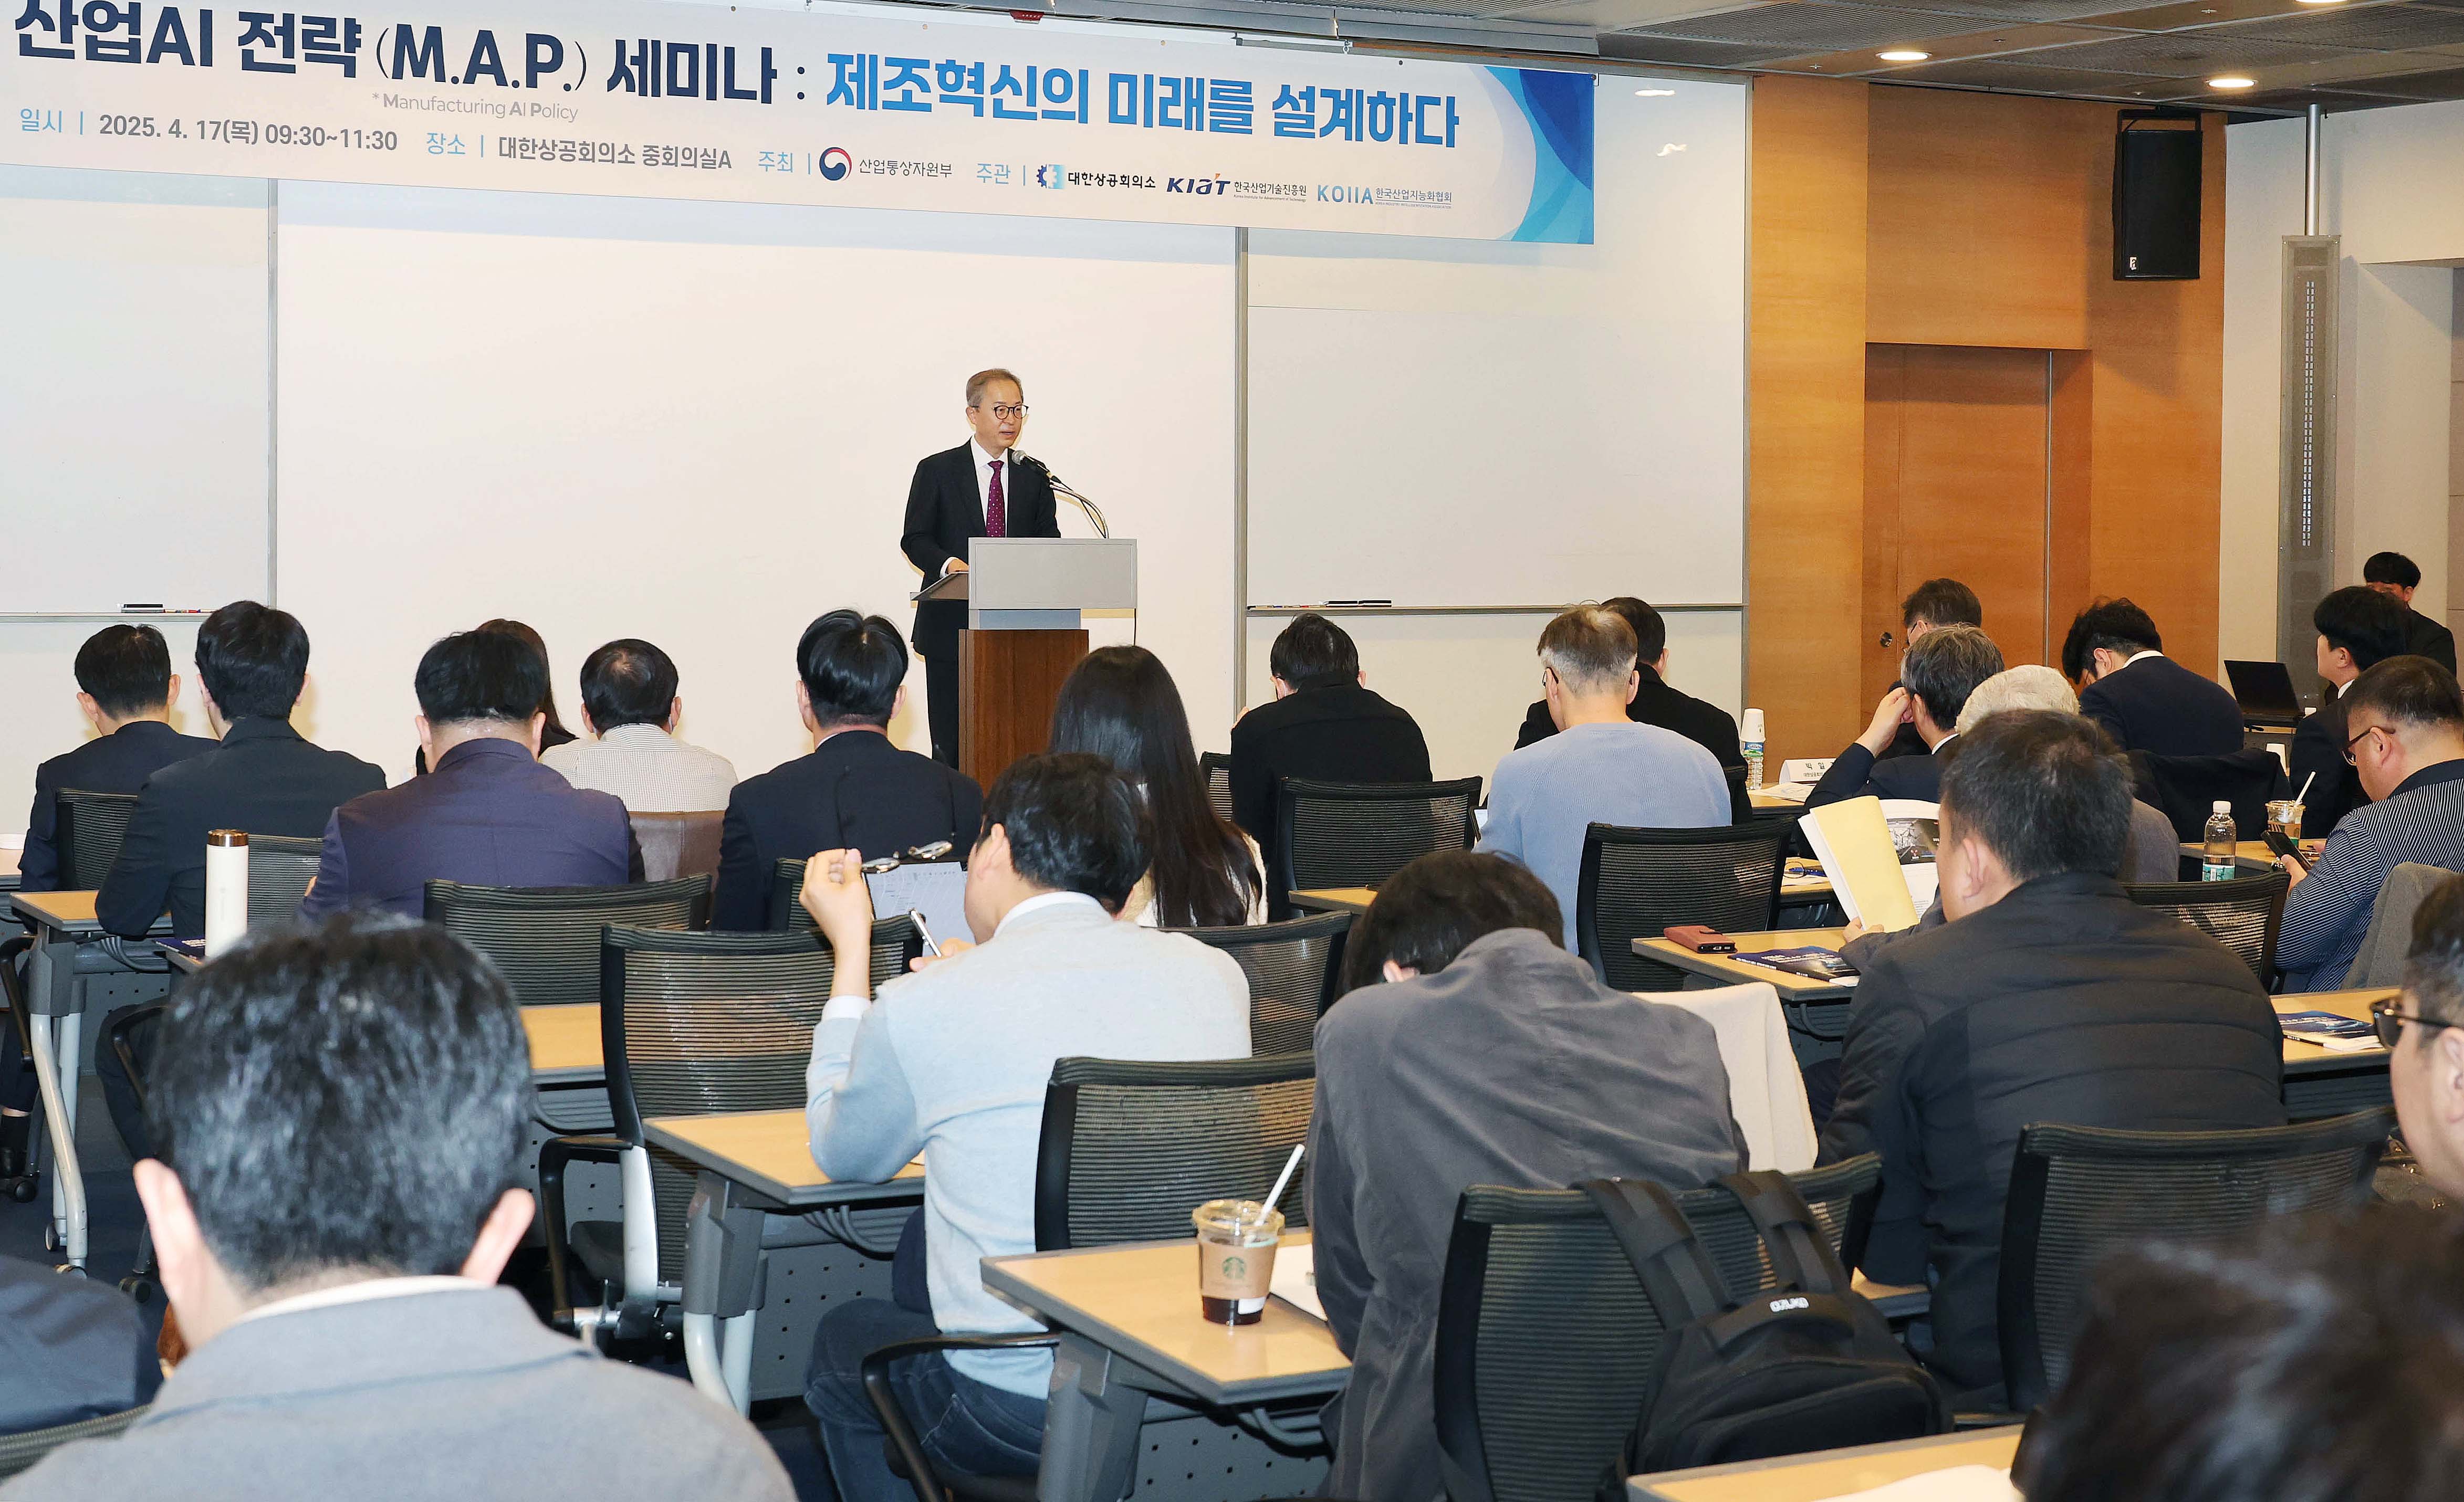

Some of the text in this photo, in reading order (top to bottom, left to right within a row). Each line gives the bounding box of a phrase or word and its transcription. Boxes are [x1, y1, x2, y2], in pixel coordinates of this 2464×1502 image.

[16, 0, 213, 67] 산업AI
[238, 12, 362, 79] 전략
[608, 39, 778, 104] 세미나
[827, 54, 1089, 124] 제조혁신의
[1109, 73, 1254, 135] 미래를
[1273, 85, 1460, 148] 설계하다
[384, 94, 579, 123] Manufacturing AI Policy
[21, 109, 62, 133] 일시
[100, 114, 161, 138] 2025.
[197, 120, 259, 145] 17(목)
[266, 124, 398, 151] 09:30~11:30
[427, 133, 732, 170] 장소 대한상공회의소 중회의실A
[759, 152, 953, 178] 주최 산업통상자원부
[977, 164, 1156, 189] 주관 대한상공회의소
[1235, 182, 1307, 196] 한국산업기술진흥원
[1318, 185, 1373, 204] KOIIA
[1376, 188, 1452, 202] 한국산업지능화협회
